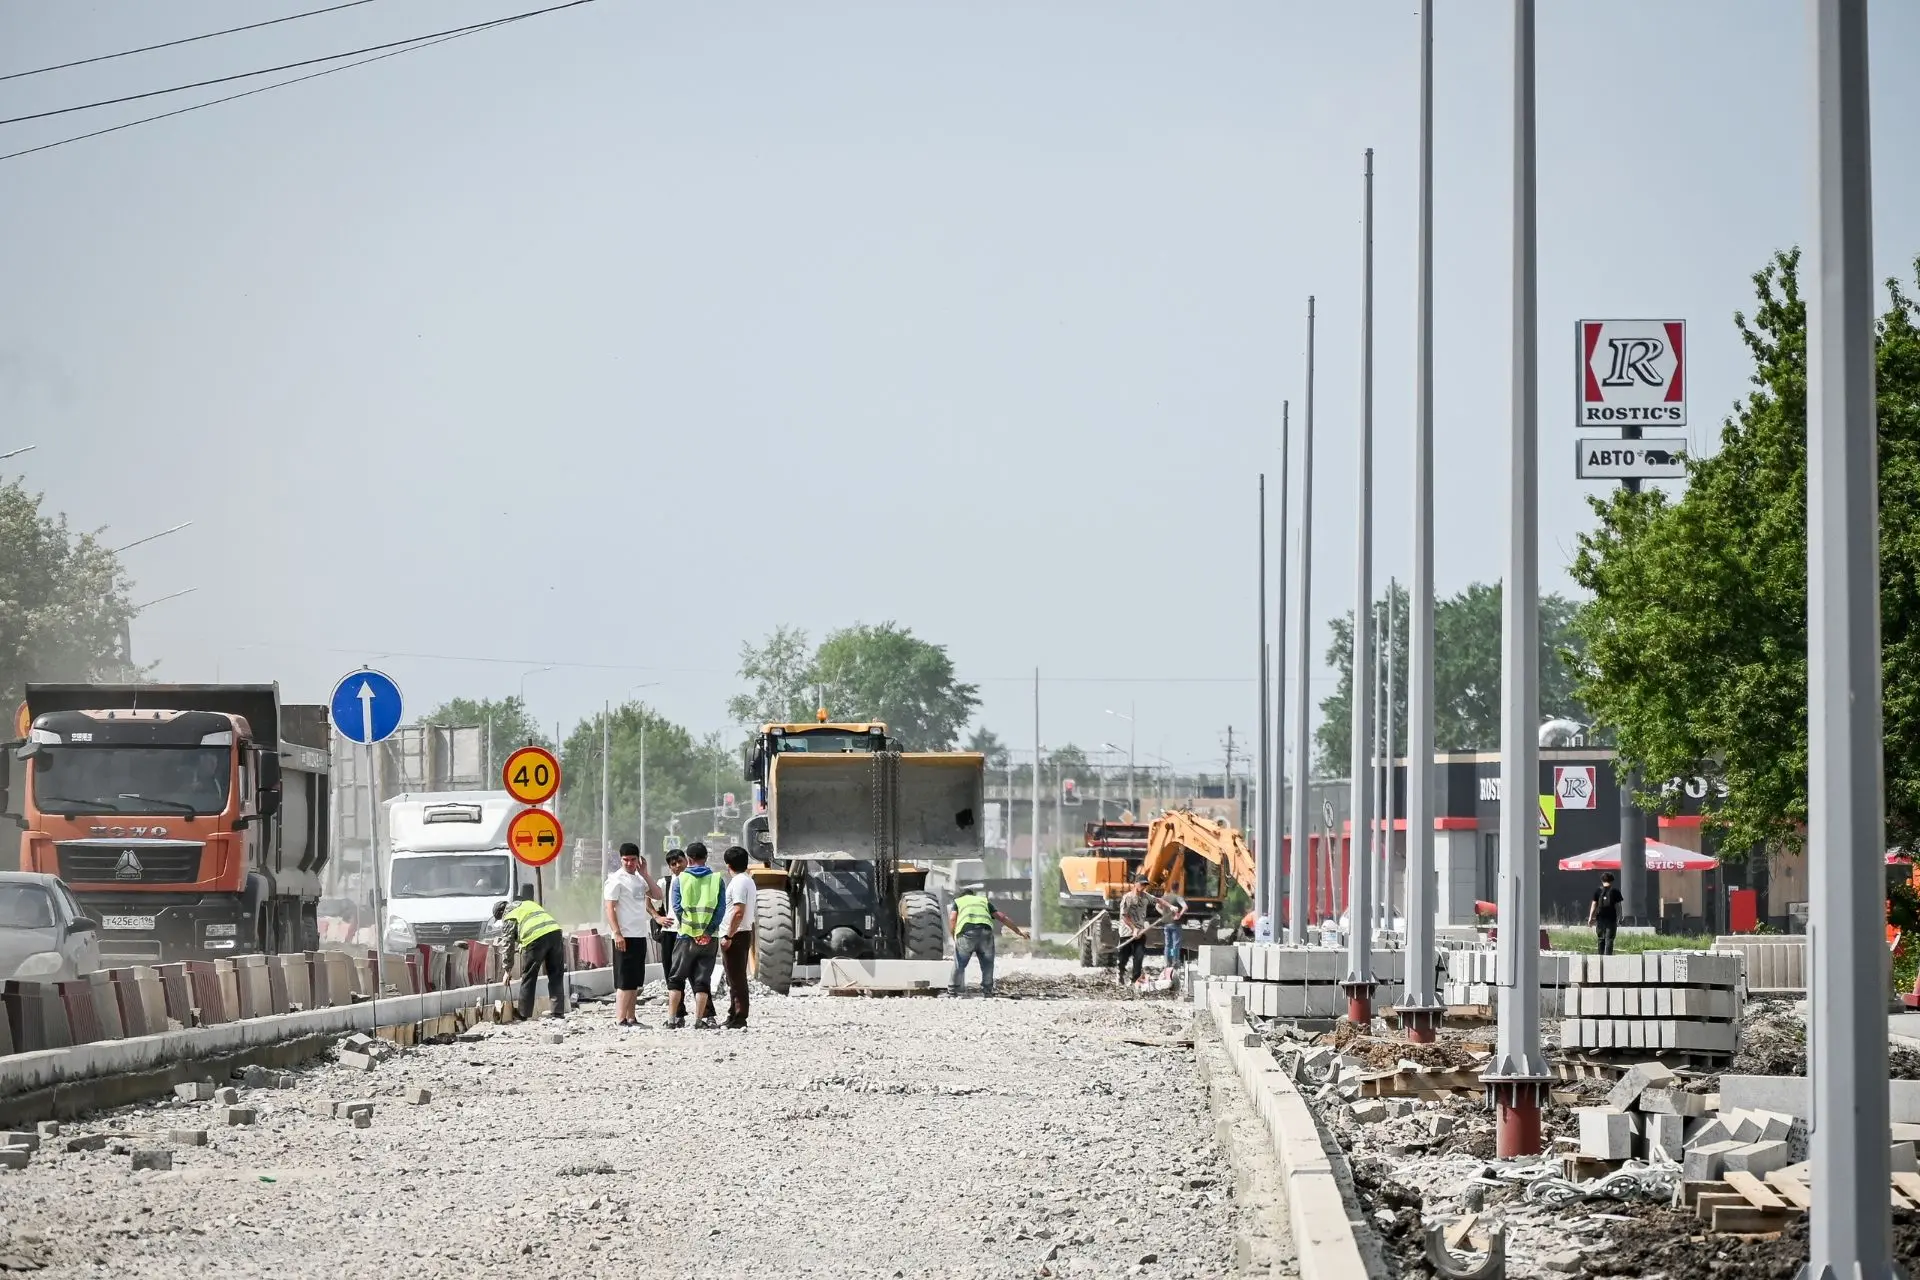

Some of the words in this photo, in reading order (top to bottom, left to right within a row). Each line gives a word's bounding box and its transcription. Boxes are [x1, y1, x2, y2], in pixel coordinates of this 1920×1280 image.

[1602, 338, 1664, 387] R
[1587, 407, 1681, 421] ROSTIC'S
[1588, 450, 1635, 466] АВТО
[513, 764, 549, 787] 40
[1562, 778, 1588, 798] R
[1646, 861, 1684, 869] STIC'S
